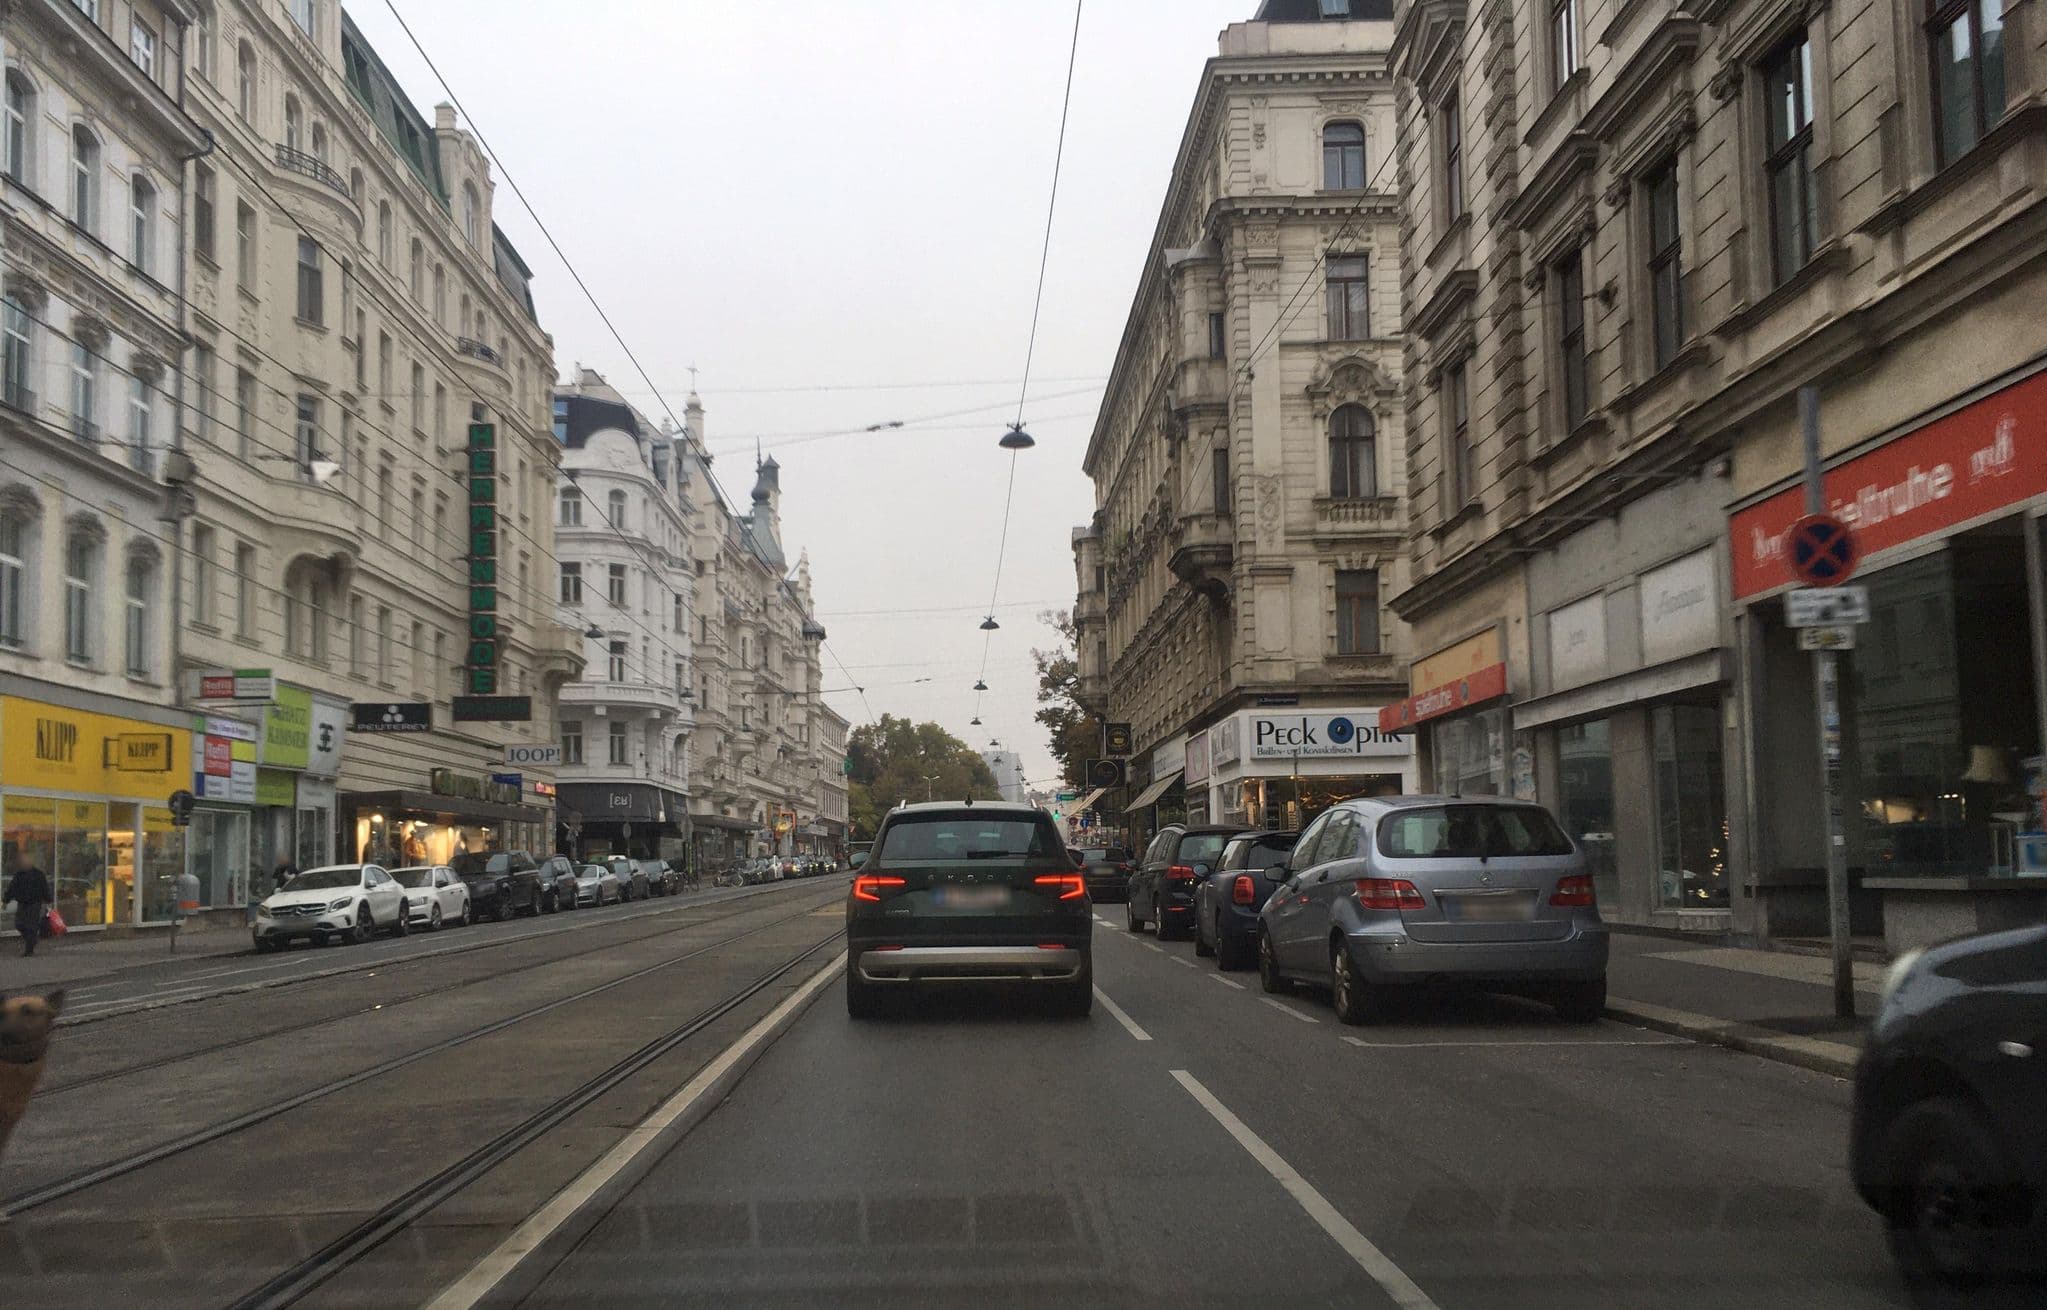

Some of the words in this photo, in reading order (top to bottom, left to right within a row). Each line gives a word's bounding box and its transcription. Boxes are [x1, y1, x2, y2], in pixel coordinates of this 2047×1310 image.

[472, 426, 494, 692] HERRENMODE
[36, 718, 77, 763] KLIPP
[127, 742, 159, 758] KLIPP
[506, 748, 560, 762] JOOP!
